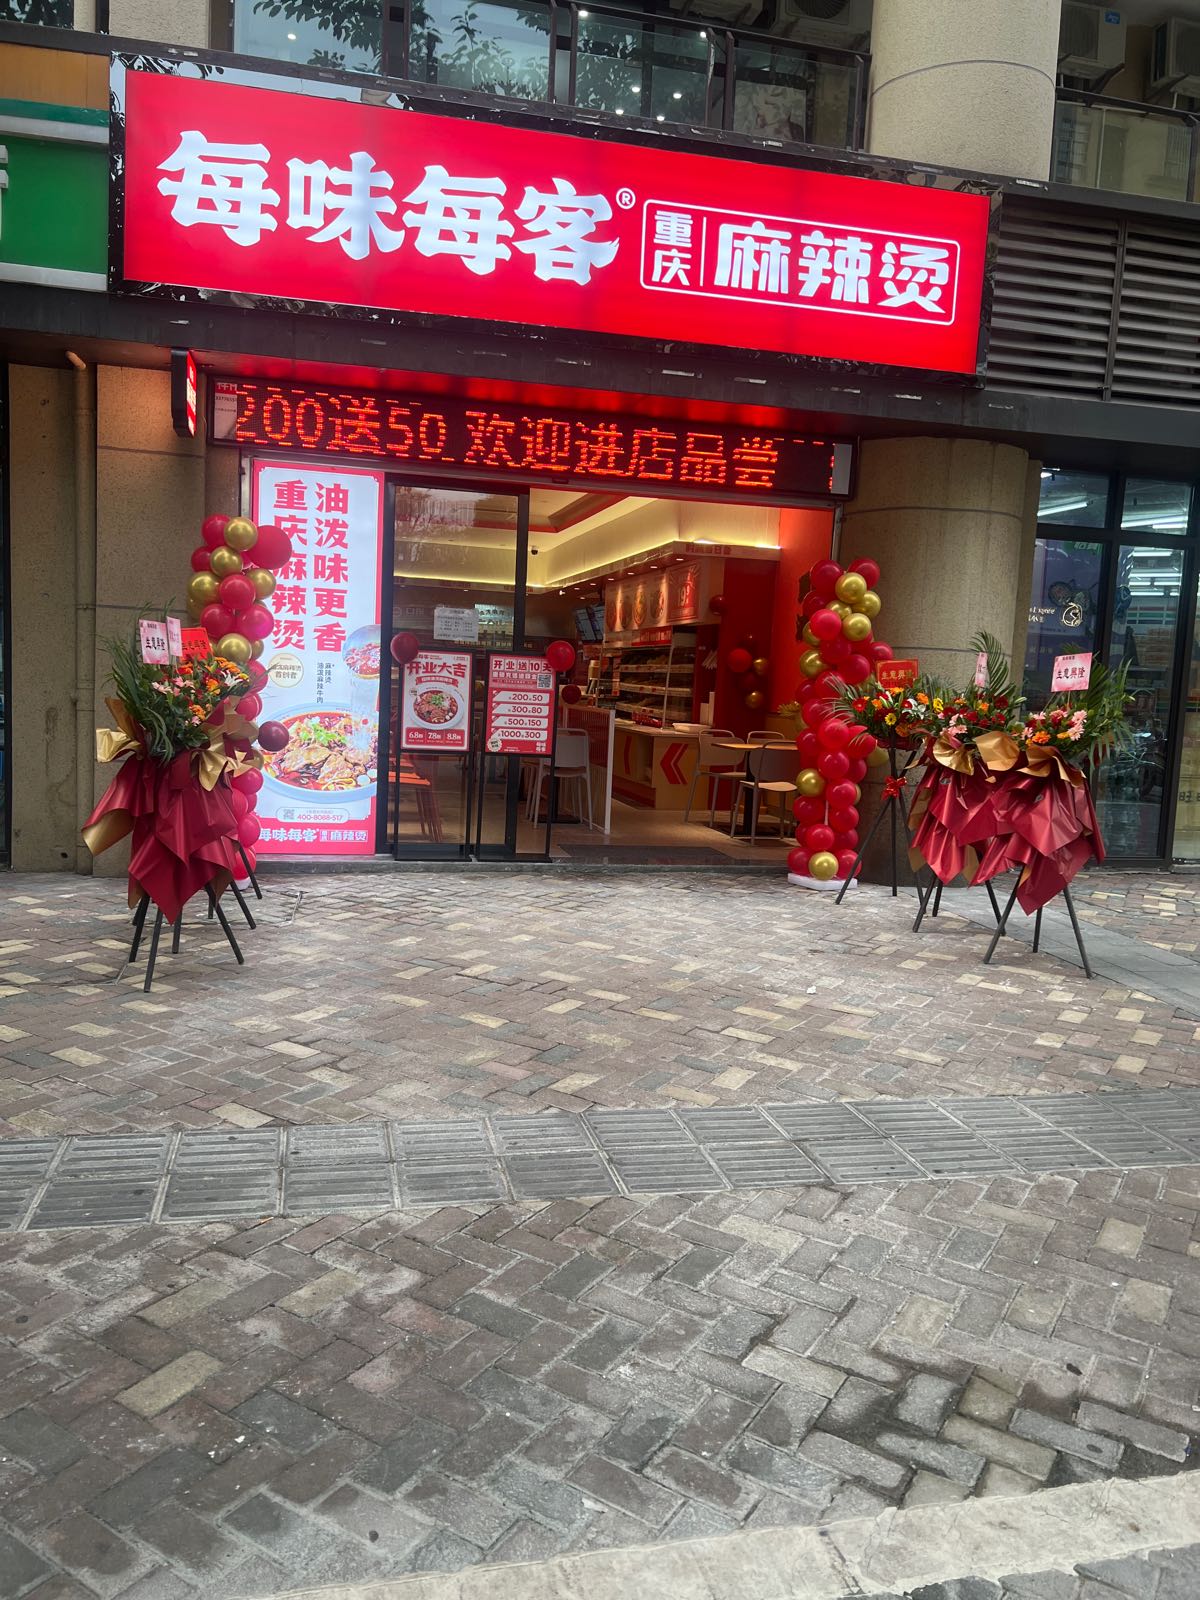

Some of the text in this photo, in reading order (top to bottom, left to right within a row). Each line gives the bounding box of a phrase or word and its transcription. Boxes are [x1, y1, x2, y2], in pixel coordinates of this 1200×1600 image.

[156, 130, 620, 285] 每味每客
[651, 210, 953, 314] 重庆 麻辣烫
[465, 411, 778, 488] 欢迎进店品尝
[272, 480, 308, 650] 重庆麻辣烫
[313, 482, 350, 652] 油泼味更香
[407, 661, 467, 678] 开业大吉
